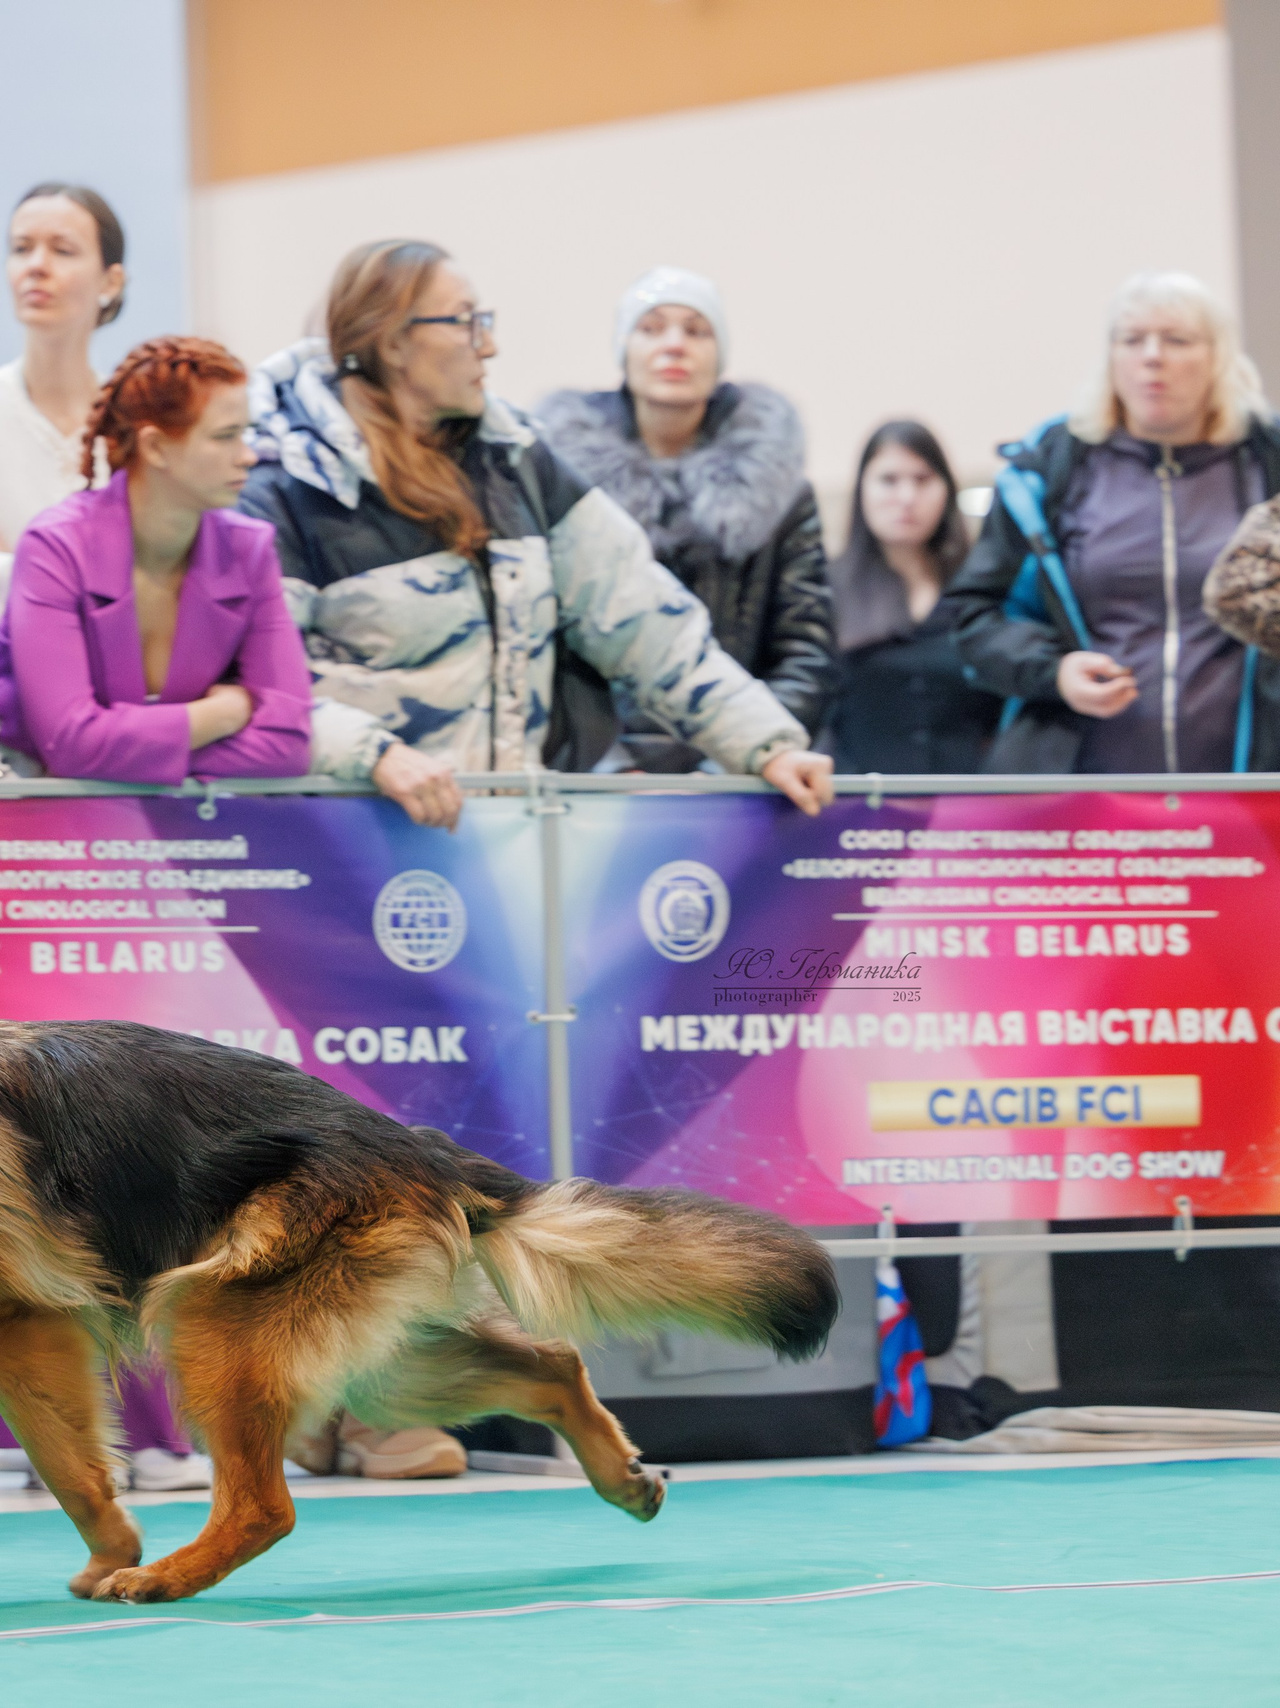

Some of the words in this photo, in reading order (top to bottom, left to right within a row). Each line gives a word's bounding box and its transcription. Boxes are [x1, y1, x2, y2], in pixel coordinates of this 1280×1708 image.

[30, 940, 225, 974] BELARUS
[865, 925, 990, 958] MINSK
[1014, 923, 1191, 958] BELARUS
[313, 1026, 468, 1065] СОБАК
[640, 1010, 1026, 1056] МЕЖДУНАРОДНАЯ
[1036, 1007, 1258, 1046] ВЫСТАВКА
[928, 1086, 1059, 1126] CACIB
[1077, 1085, 1143, 1122] FCI
[842, 1154, 1059, 1186] INTERNATIONAL
[1064, 1152, 1133, 1181] DOG
[1138, 1150, 1226, 1179] SHOW
